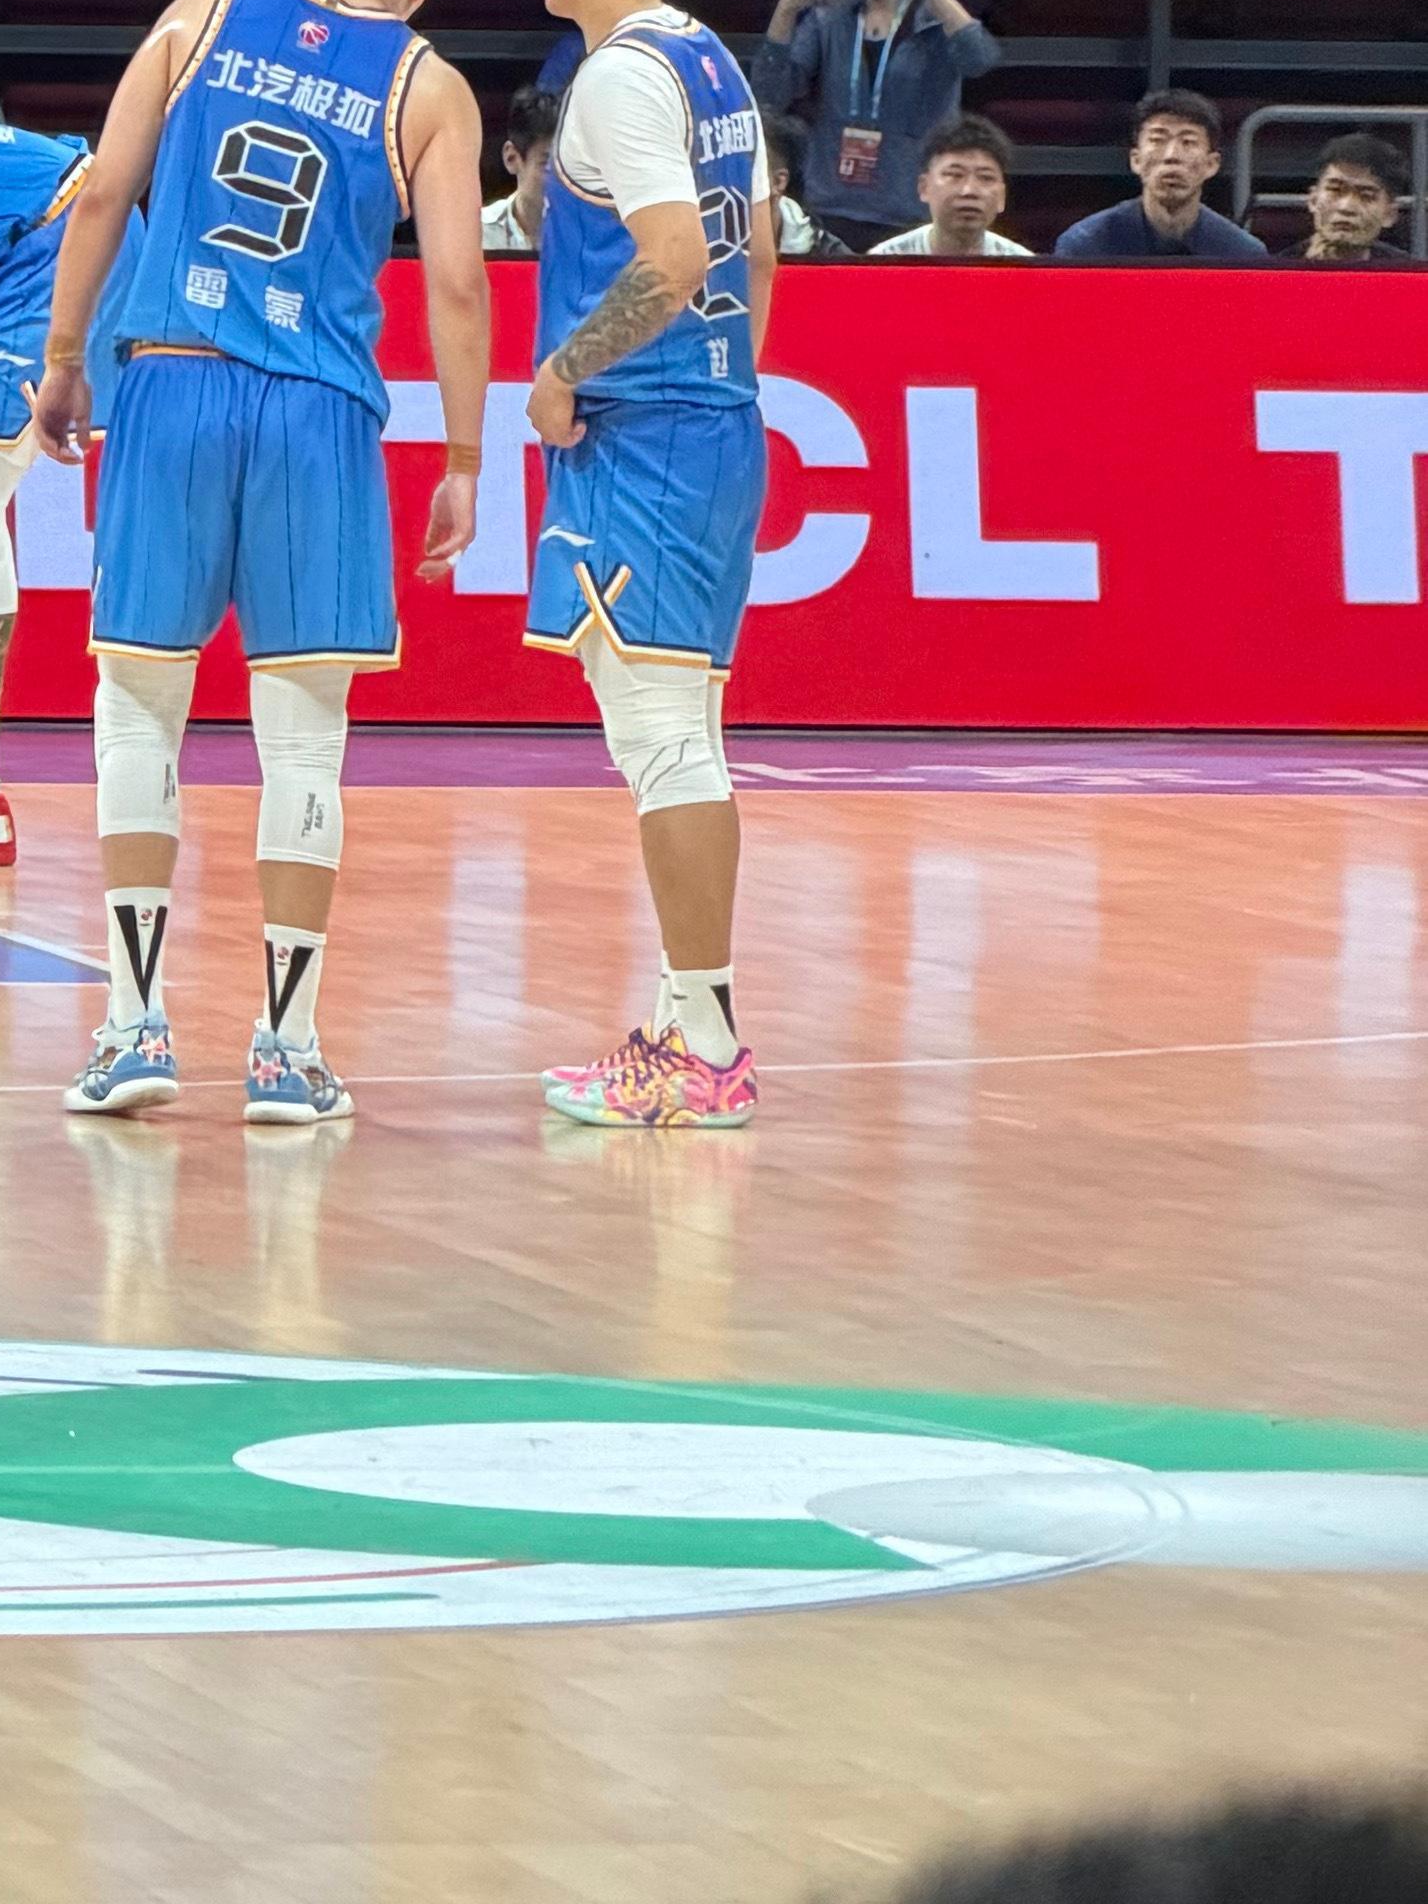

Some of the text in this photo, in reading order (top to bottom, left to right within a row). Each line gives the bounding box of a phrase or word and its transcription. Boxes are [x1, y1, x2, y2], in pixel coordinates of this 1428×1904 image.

[205, 48, 383, 141] 北汽极狐
[198, 118, 330, 263] 9
